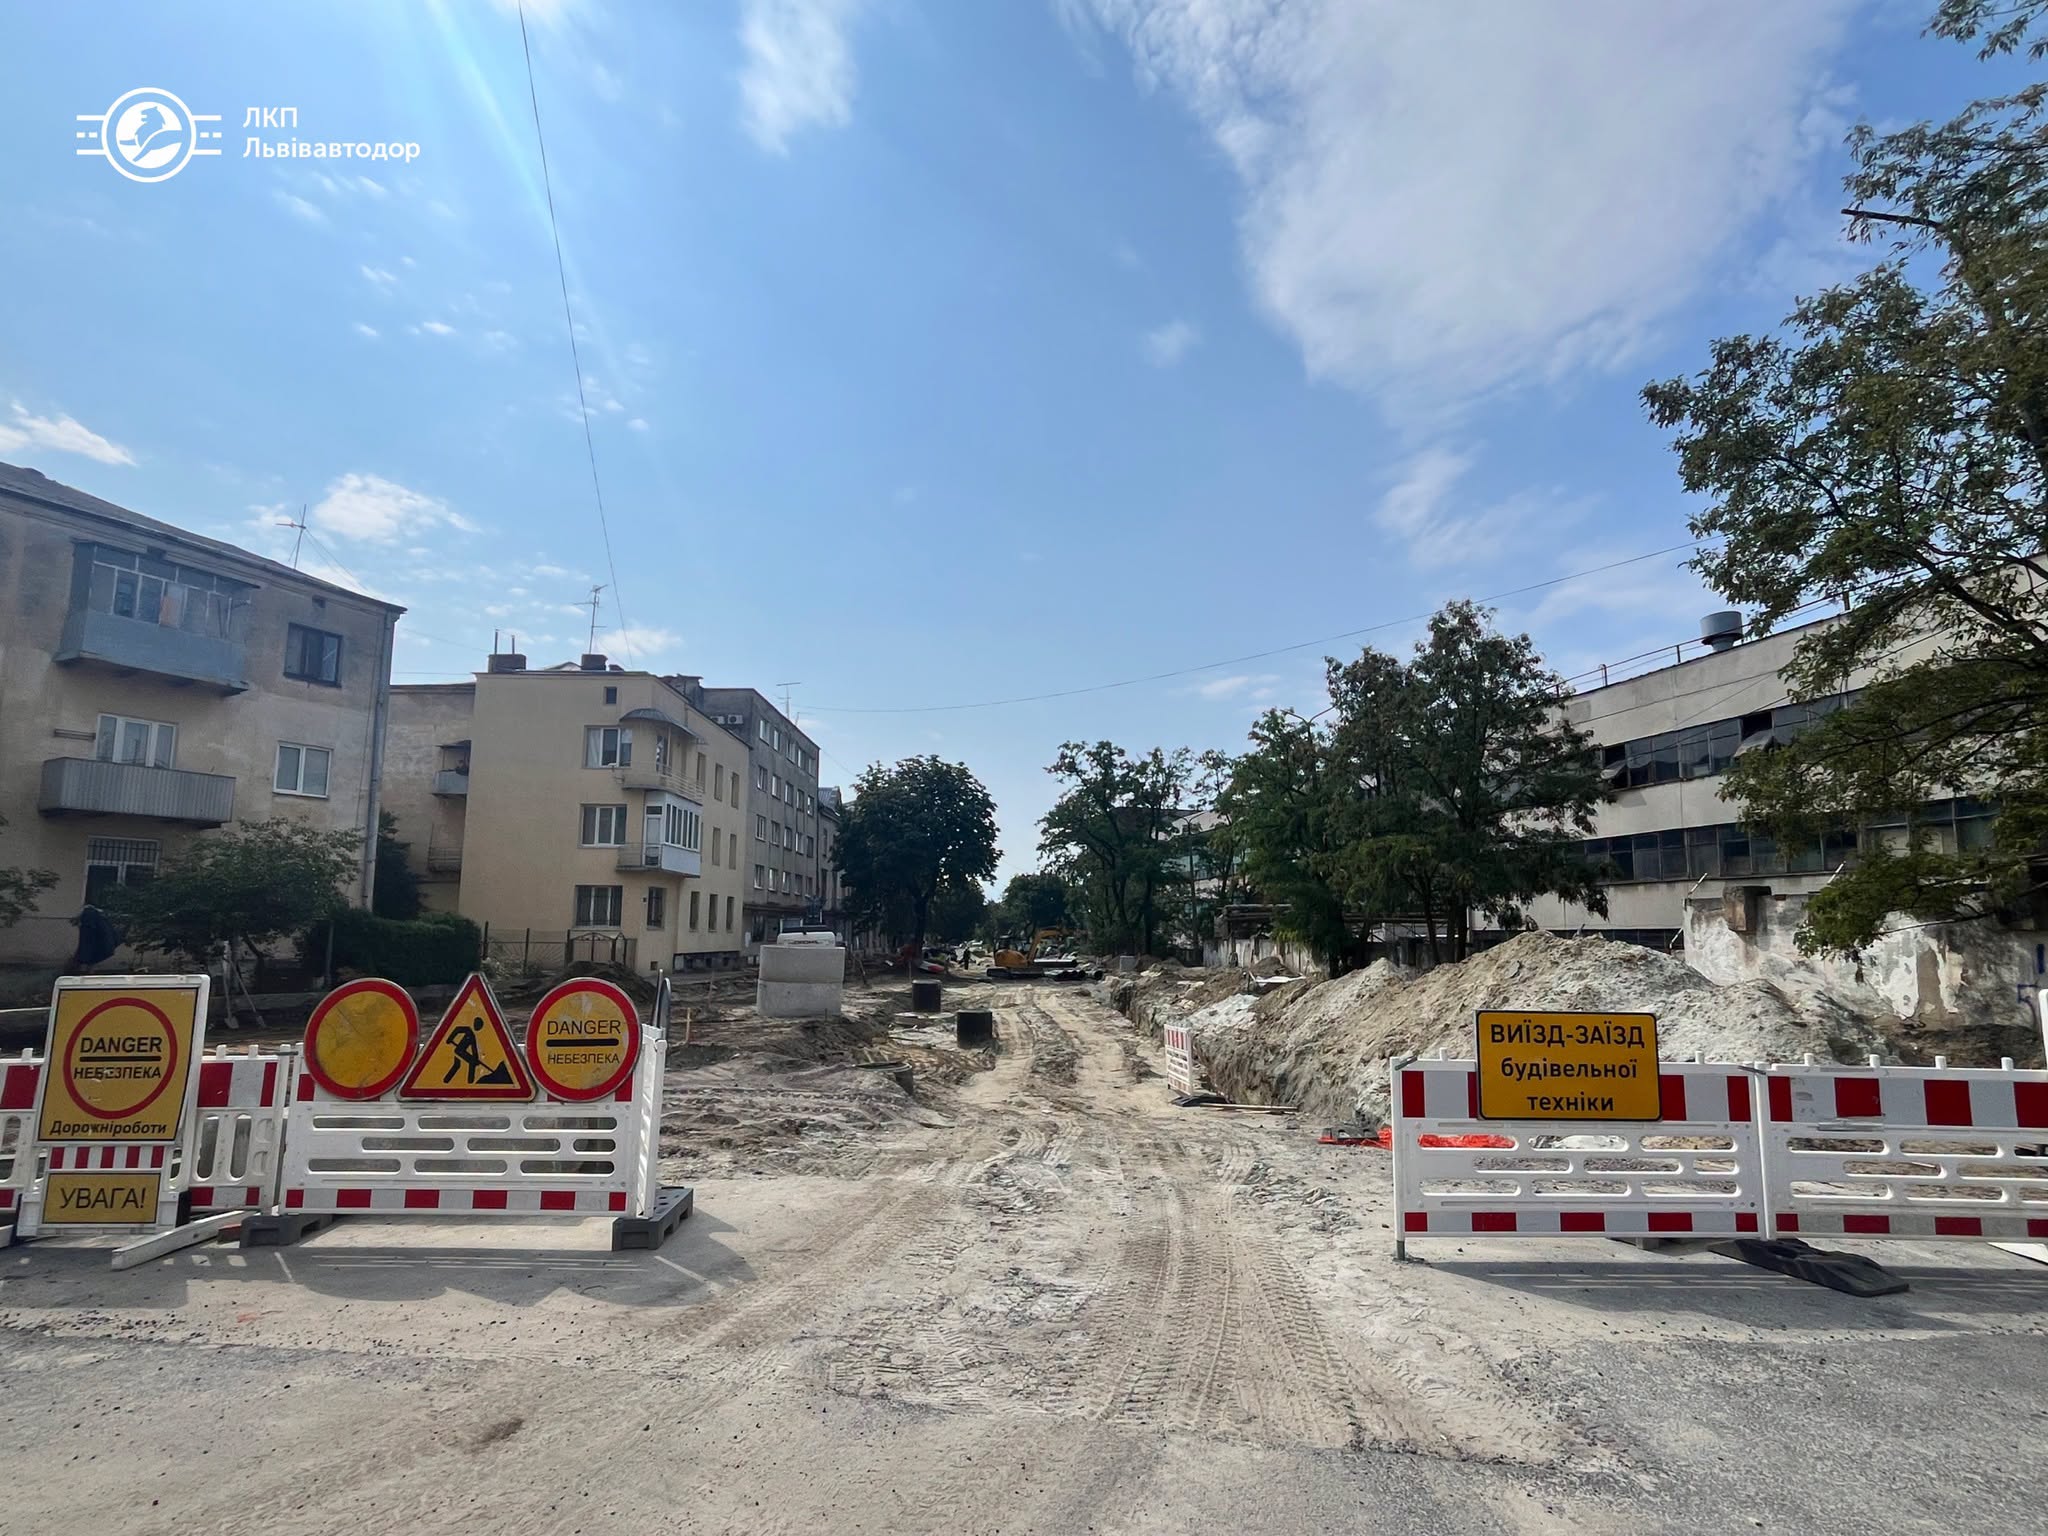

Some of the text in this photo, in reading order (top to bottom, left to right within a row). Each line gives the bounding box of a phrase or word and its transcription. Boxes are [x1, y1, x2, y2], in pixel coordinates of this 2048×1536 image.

[547, 1019, 621, 1035] DANGER
[1490, 1019, 1645, 1048] ВИЇЗД-ЗАЇЗД
[79, 1037, 162, 1053] DANGER
[547, 1053, 620, 1065] НЕБЕЗПЕКА
[73, 1066, 162, 1080] НЕБЕЗПЕКА
[1501, 1057, 1637, 1081] будівельної
[1526, 1091, 1614, 1112] техніки
[59, 1187, 146, 1209] УВАГА!
